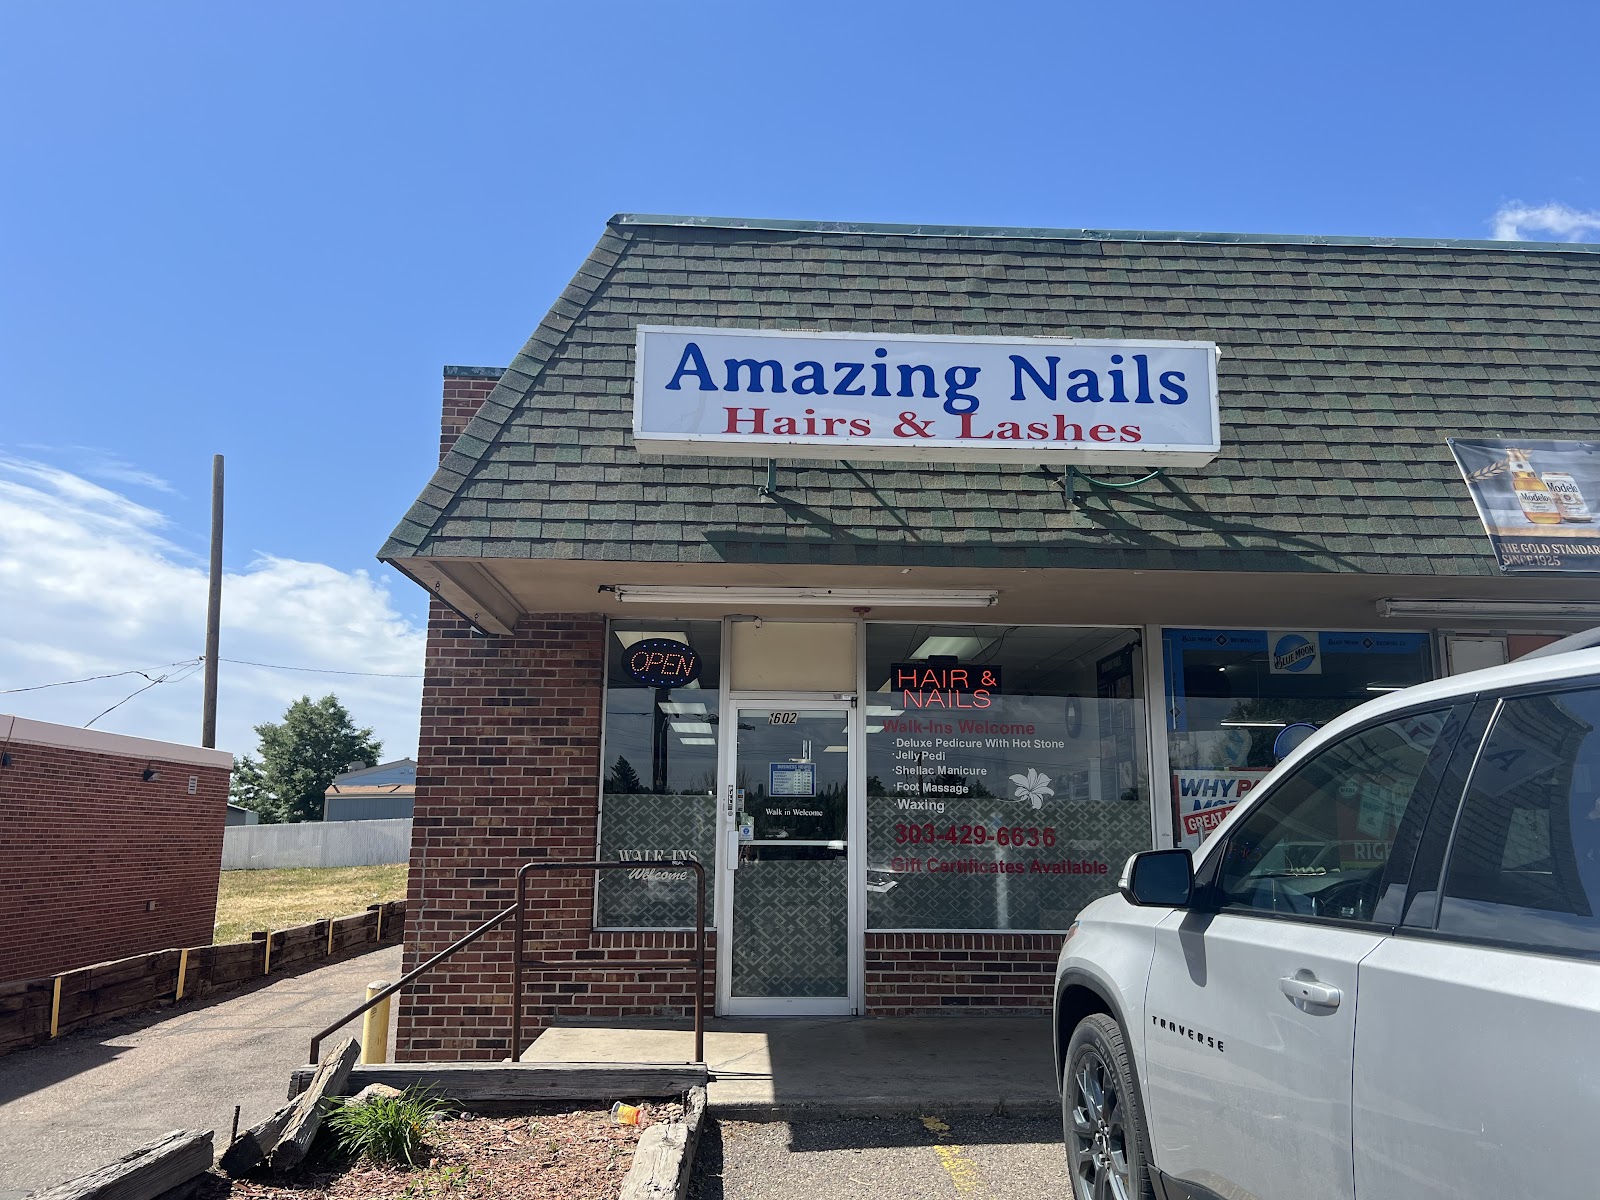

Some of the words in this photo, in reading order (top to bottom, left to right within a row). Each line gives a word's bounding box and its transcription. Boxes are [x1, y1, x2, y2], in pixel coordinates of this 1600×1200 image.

[665, 342, 981, 415] Amazing
[1010, 354, 1188, 405] Nails
[722, 407, 871, 438] Hairs
[893, 410, 935, 438] &
[956, 412, 1142, 443] Lashes
[1547, 482, 1578, 493] Modelo
[1497, 543, 1520, 554] THE
[1521, 543, 1550, 554] GOLD
[1551, 544, 1600, 555] STANDAR
[1502, 555, 1535, 566] SINCE
[1535, 555, 1560, 566] 1925
[631, 651, 696, 677] OPEN
[1274, 655, 1295, 669] BLUE
[1294, 645, 1315, 660] MOON
[898, 669, 968, 688] HAIR
[981, 670, 997, 687] &
[904, 689, 991, 708] NAILS
[769, 712, 797, 725] 1602
[882, 719, 953, 734] Walk-Ins
[958, 720, 1035, 735] Welcome
[896, 738, 933, 748] Deluxe
[935, 738, 982, 748] Pedicure
[985, 738, 1010, 748] With
[1012, 739, 1031, 748] Hot
[1033, 739, 1065, 749] Stone
[895, 751, 920, 762] Jelly
[921, 751, 946, 761] Pedi
[895, 766, 935, 776] Shellac
[937, 766, 988, 776] Manicure
[896, 782, 920, 792] Foot
[922, 783, 969, 794] Massage
[1180, 778, 1236, 798] WHY
[765, 808, 783, 816] Walk
[784, 808, 791, 816] in
[792, 808, 823, 817] Welcome
[897, 799, 945, 813] Waxing
[1187, 812, 1222, 831] GREAT
[895, 823, 1056, 847] 303-429-6636
[618, 849, 698, 862] WALK-INS
[626, 867, 688, 881] Welcome
[891, 858, 922, 874] Gift
[926, 858, 1025, 874] Certificates
[1029, 860, 1108, 875] Available
[1152, 1015, 1224, 1052] TRAVERSE
